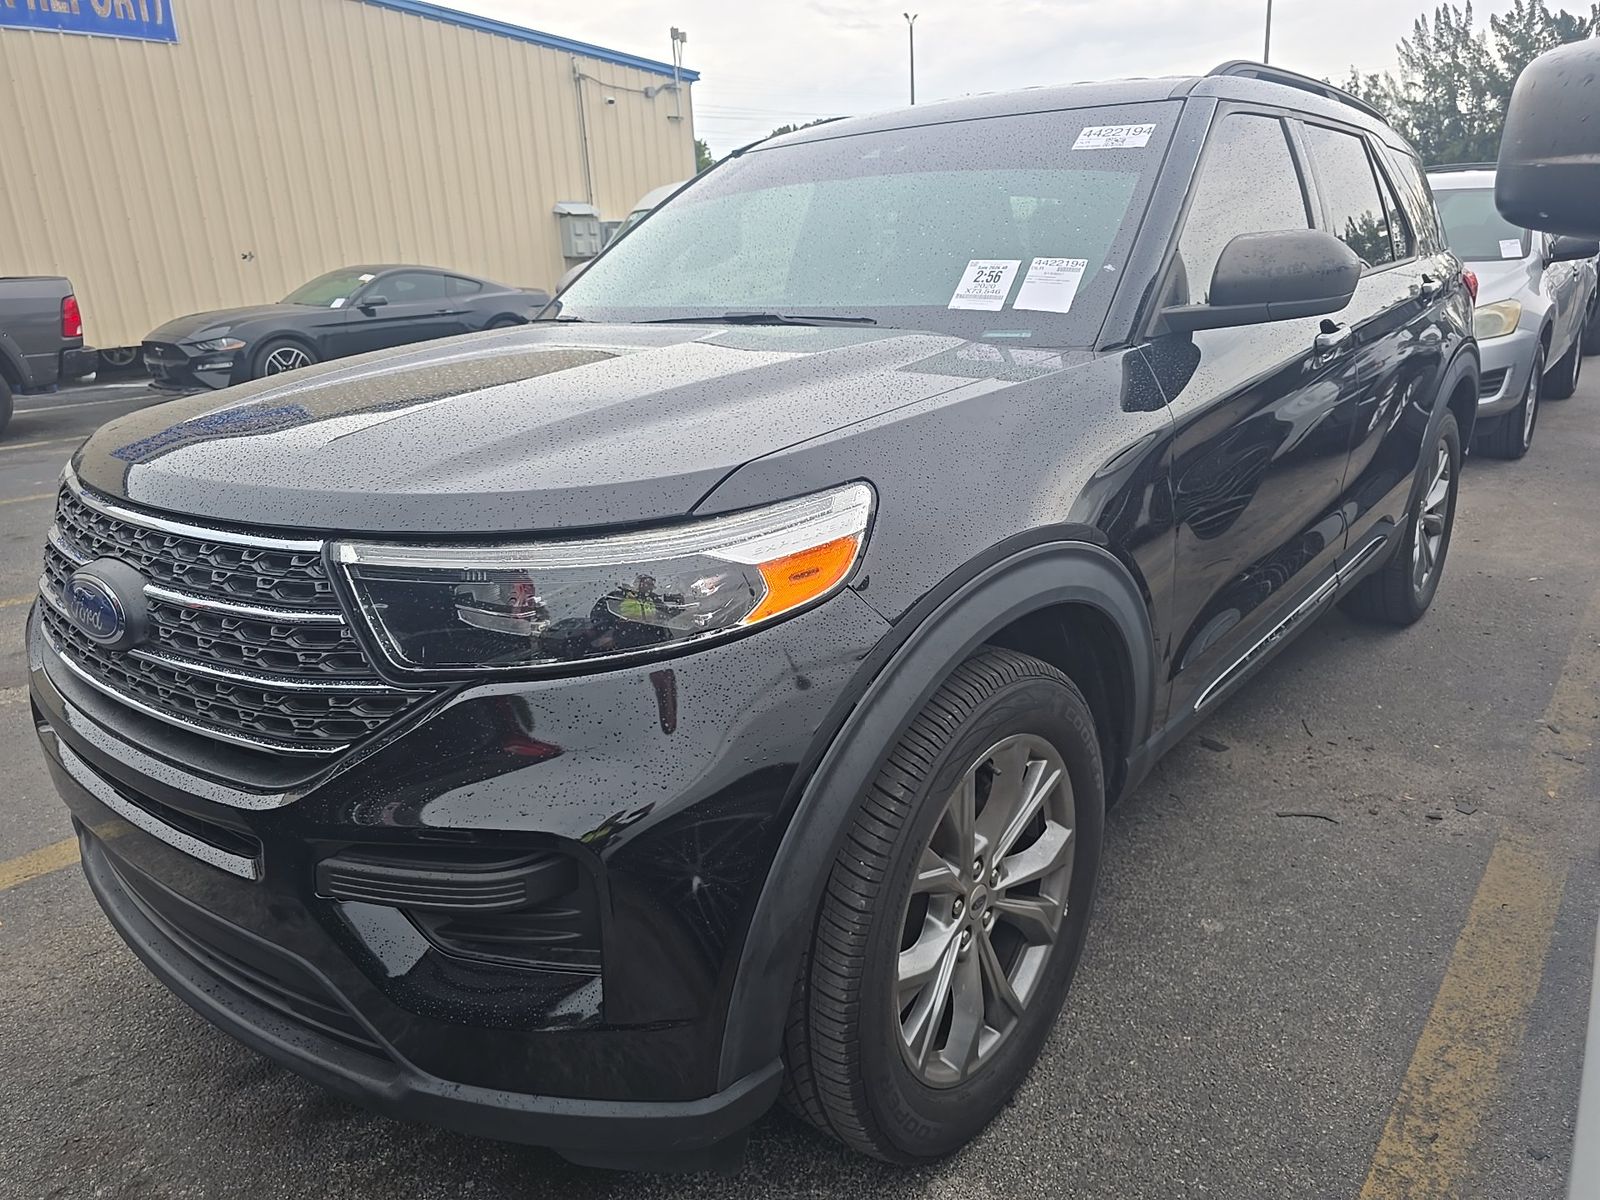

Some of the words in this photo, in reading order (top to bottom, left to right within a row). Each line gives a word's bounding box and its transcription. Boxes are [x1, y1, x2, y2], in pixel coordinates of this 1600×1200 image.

[1083, 126, 1153, 138] 4422194
[1034, 259, 1086, 268] 4422194
[973, 270, 1003, 283] 2:56
[70, 585, 103, 631] Ford
